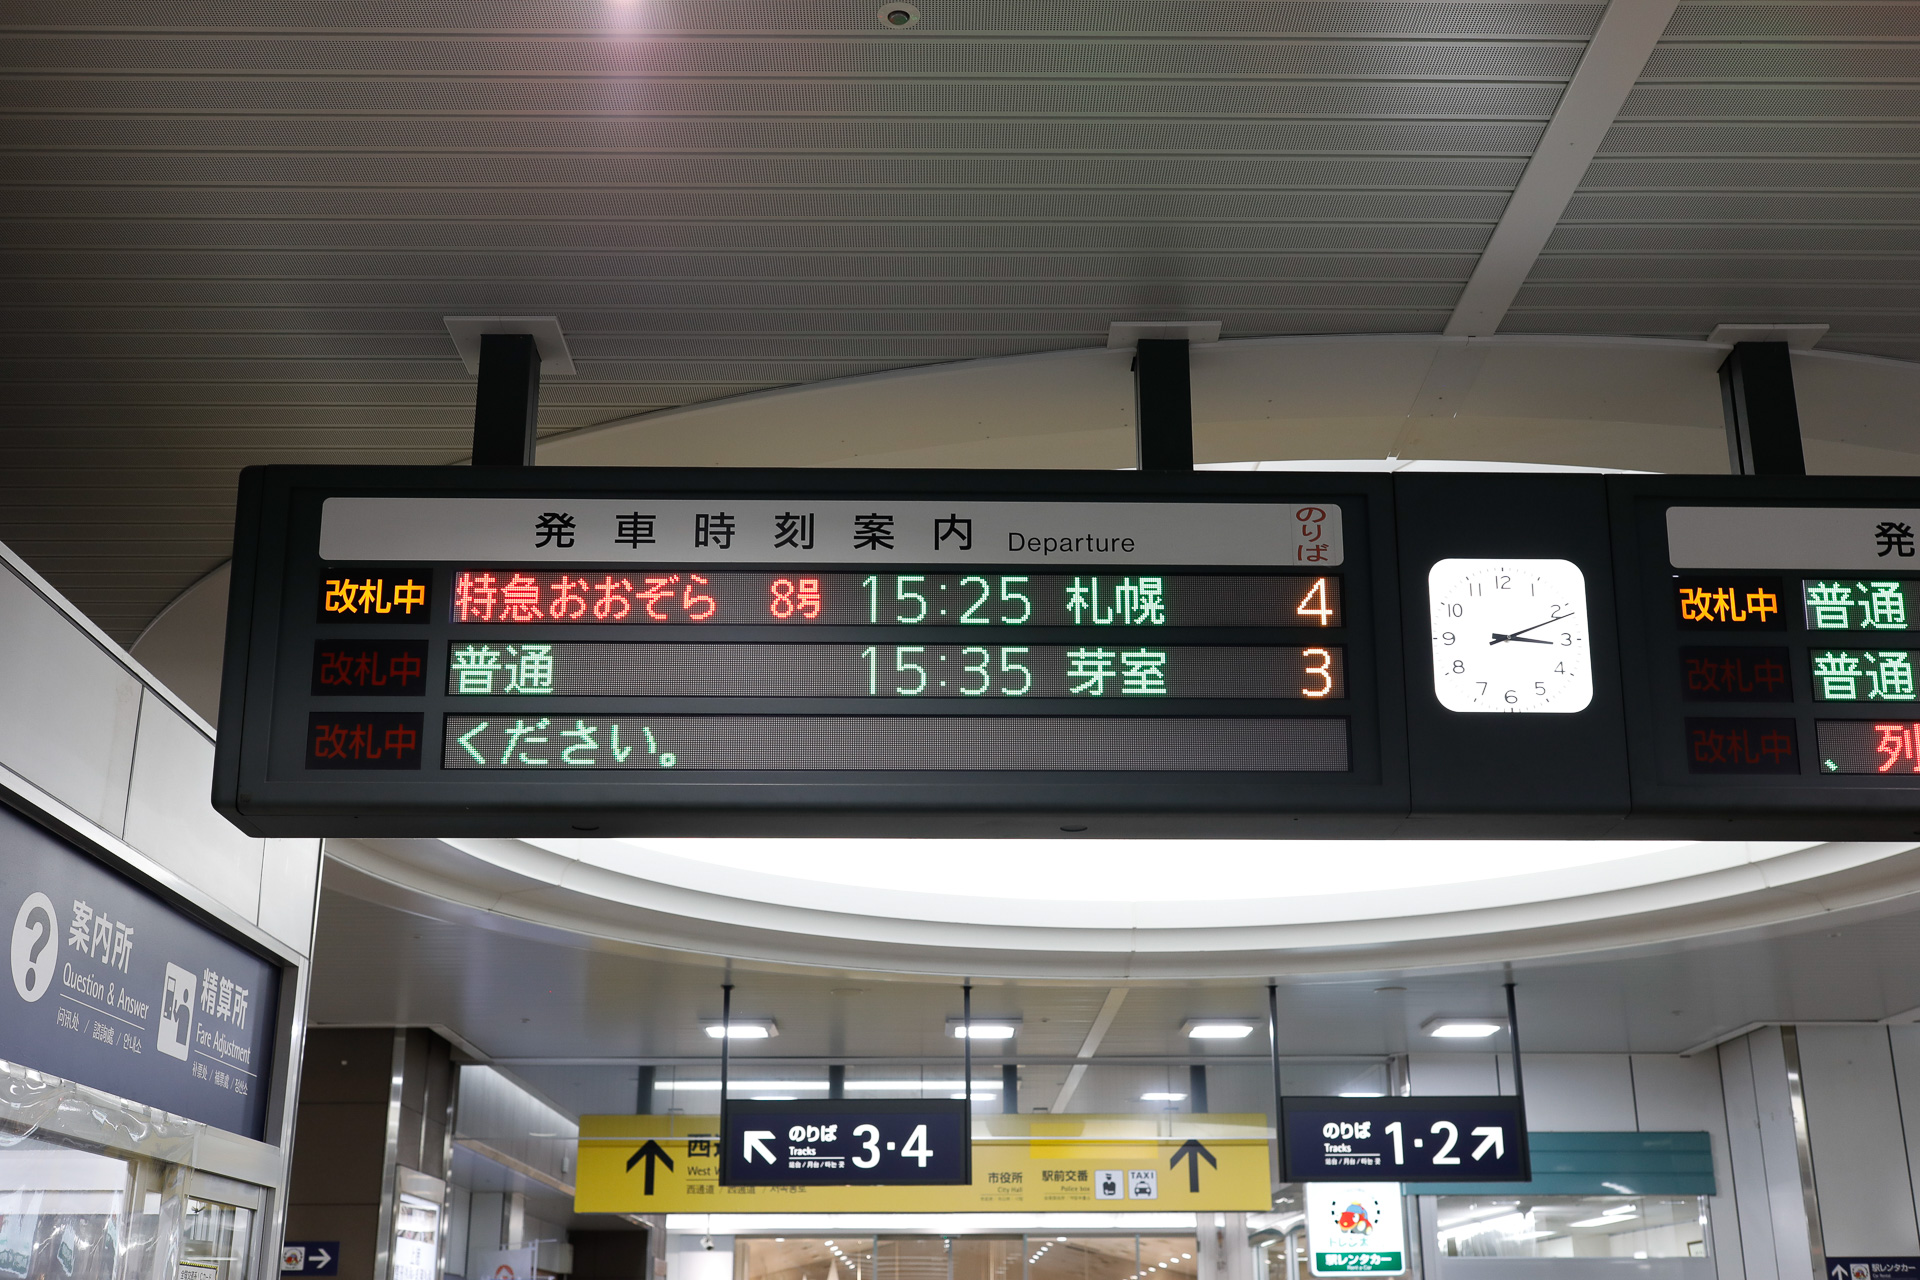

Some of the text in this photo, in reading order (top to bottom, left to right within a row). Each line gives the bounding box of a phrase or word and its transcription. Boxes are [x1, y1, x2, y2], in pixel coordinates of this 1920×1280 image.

[535, 511, 972, 551] 発車時刻案内
[1008, 531, 1136, 554] Departure
[1295, 506, 1329, 563] のりば
[1874, 521, 1916, 558] 発
[325, 578, 426, 615] 改札中
[454, 573, 821, 621] 特急おおぞら 8号
[862, 575, 1031, 624] 15:25
[1470, 583, 1482, 597] 11
[1496, 575, 1511, 590] 12
[1065, 576, 1166, 625] 札幌
[1296, 577, 1333, 626] 4
[1447, 603, 1463, 618] 10
[1550, 604, 1561, 619] 2
[1679, 587, 1779, 623] 改札中
[1807, 581, 1908, 630] 普通
[1442, 632, 1456, 646] 9
[1560, 632, 1573, 647] 3
[320, 652, 422, 687] 改札中
[451, 644, 554, 694] 普通
[862, 645, 1032, 696] 15:35
[1066, 647, 1167, 696] 芽室
[1301, 647, 1332, 697] 3
[1452, 659, 1466, 675] 8
[1553, 661, 1566, 675] 4
[1686, 658, 1785, 693] 改札中
[1814, 651, 1916, 701] 普通
[1475, 681, 1488, 696] 7
[1504, 689, 1518, 704] 6
[1534, 681, 1546, 696] 5
[314, 723, 417, 760] 改札中
[456, 717, 677, 768] ください。
[1692, 729, 1792, 764] 改札中
[68, 899, 135, 975] 案内所
[63, 962, 150, 1020] Question & Answer
[200, 967, 249, 1030] 精算所
[196, 1022, 251, 1065] Fare Adjustment
[687, 1134, 720, 1158] 西
[788, 1124, 838, 1143] のりば
[1322, 1121, 1372, 1140] のりば
[1324, 1143, 1352, 1153] Tracks
[788, 1146, 817, 1156] Tracks
[687, 1166, 711, 1176] West
[988, 1171, 1023, 1184] 市役所
[1042, 1170, 1089, 1182] 駅前交番
[1130, 1171, 1155, 1180] TAXI
